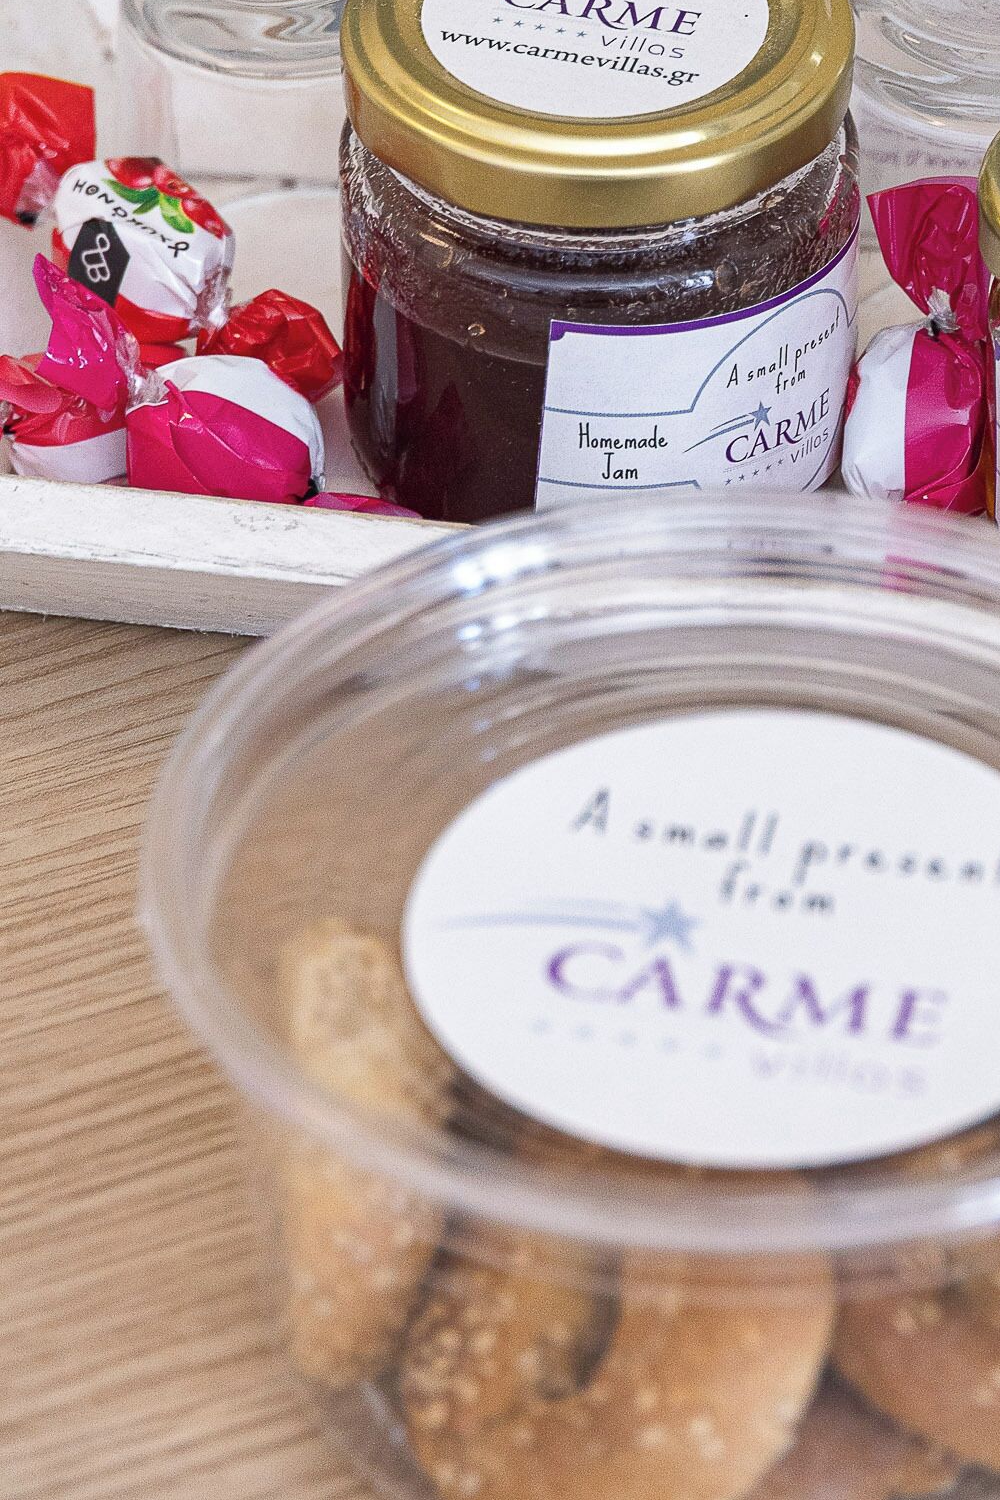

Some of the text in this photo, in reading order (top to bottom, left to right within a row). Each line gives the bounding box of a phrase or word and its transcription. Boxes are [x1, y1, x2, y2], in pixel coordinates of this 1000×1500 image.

[440, 28, 701, 87] www.carmevillas.gr
[601, 32, 686, 60] villas
[726, 305, 840, 389] A small present
[775, 368, 806, 395] from
[578, 422, 668, 450] Homemade
[725, 387, 830, 464] CARME
[790, 428, 830, 464] villas
[601, 452, 638, 480] Jam
[570, 787, 610, 833] A
[632, 808, 779, 858] small
[718, 859, 836, 916] from
[542, 940, 951, 1043] CARME
[748, 1049, 927, 1097] villas
